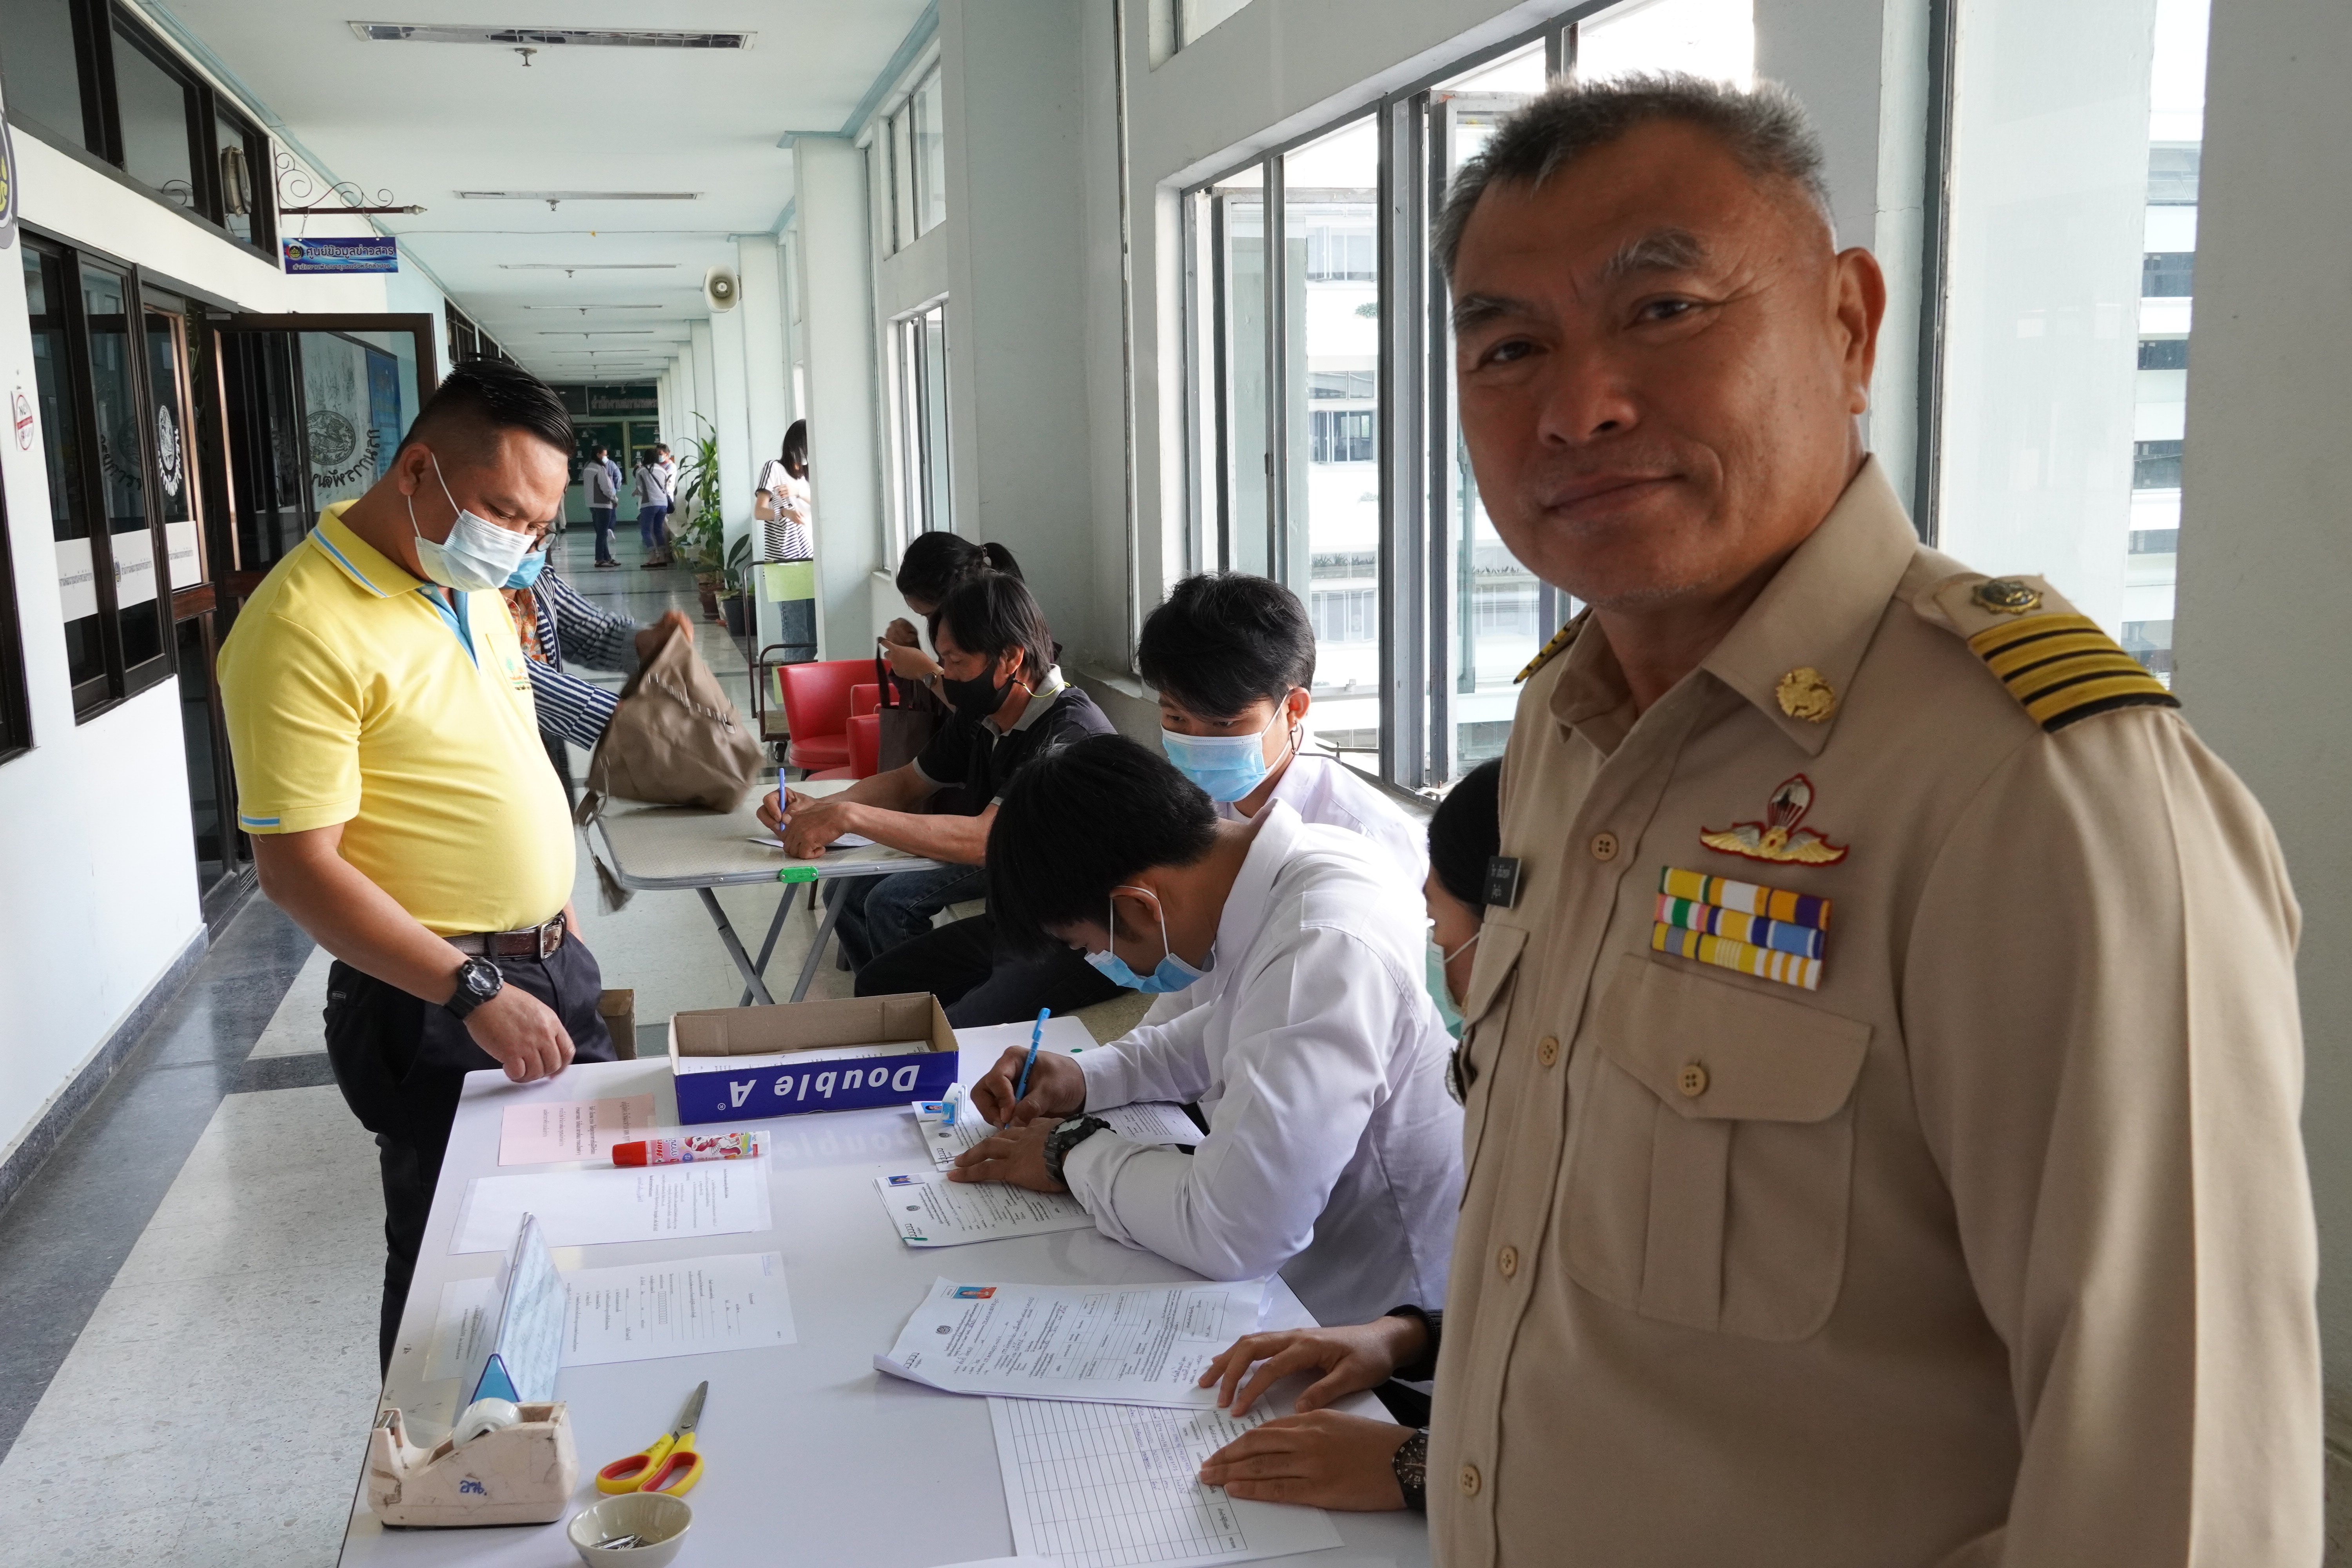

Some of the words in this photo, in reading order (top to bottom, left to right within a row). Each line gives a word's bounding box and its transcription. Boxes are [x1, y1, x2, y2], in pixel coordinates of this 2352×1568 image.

[306, 245, 394, 259] ศูนย์ข้อมูลข่าวสาร
[292, 263, 390, 271] สำนักงานพัฒนาชุมชนจังหวัดลำปาง
[774, 1065, 920, 1101] Double
